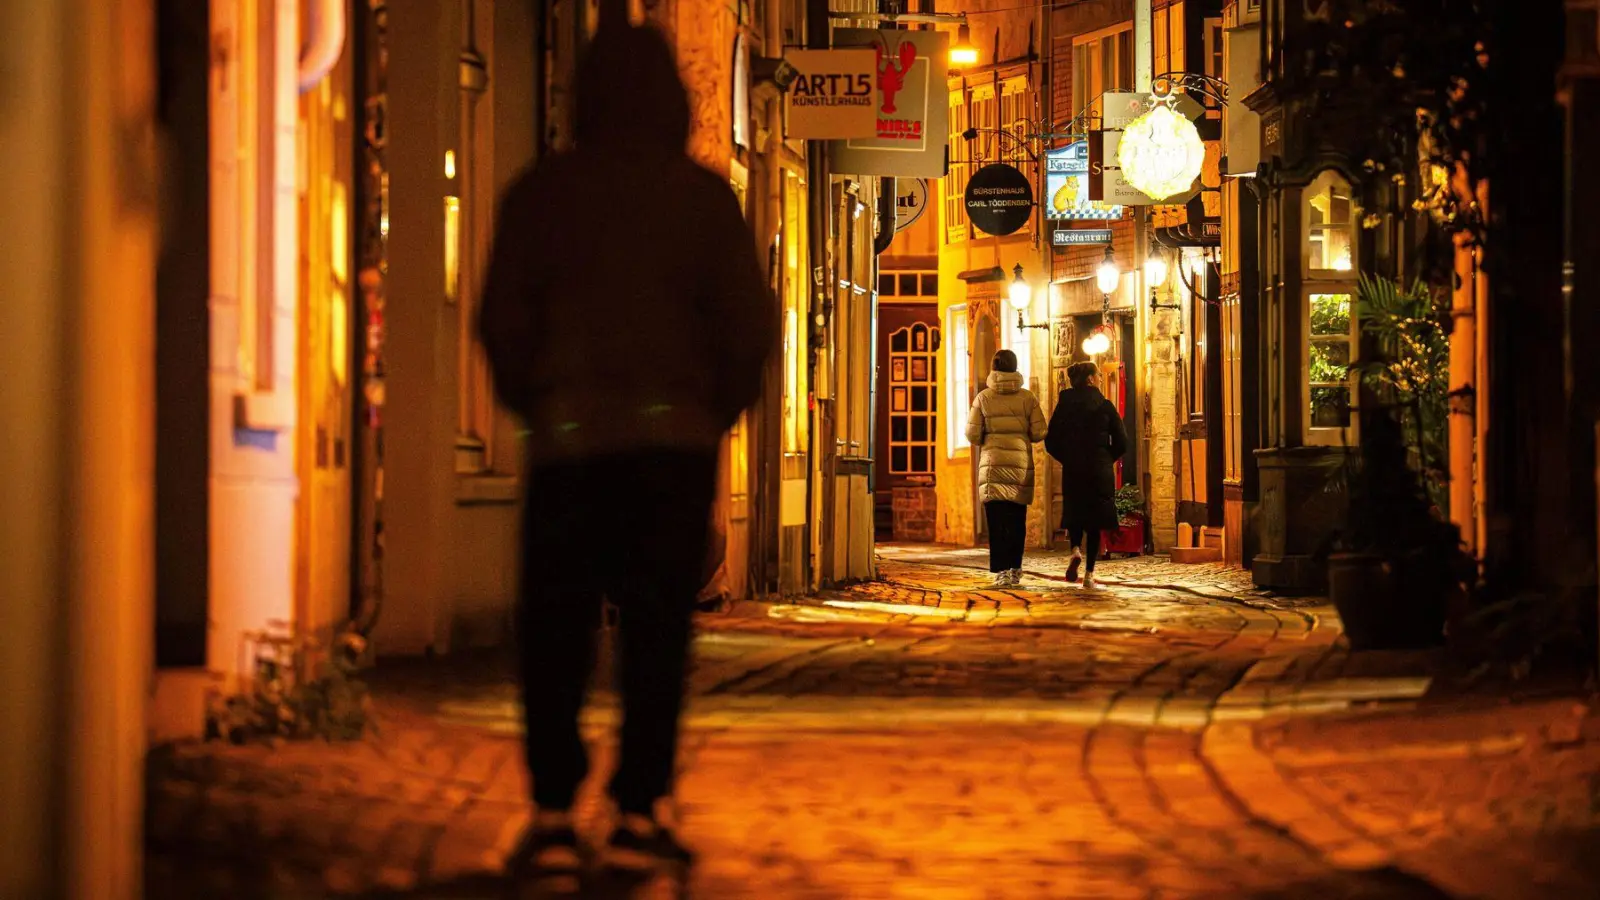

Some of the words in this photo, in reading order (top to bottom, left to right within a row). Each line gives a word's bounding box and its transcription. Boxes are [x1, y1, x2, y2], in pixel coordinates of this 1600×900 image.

[793, 74, 872, 96] ART15
[792, 96, 872, 107] KÜNSTLERHAUS
[973, 187, 1025, 195] BÜRSTENHAUS
[968, 200, 987, 208] CARL
[1055, 232, 1111, 243] Restaurant
